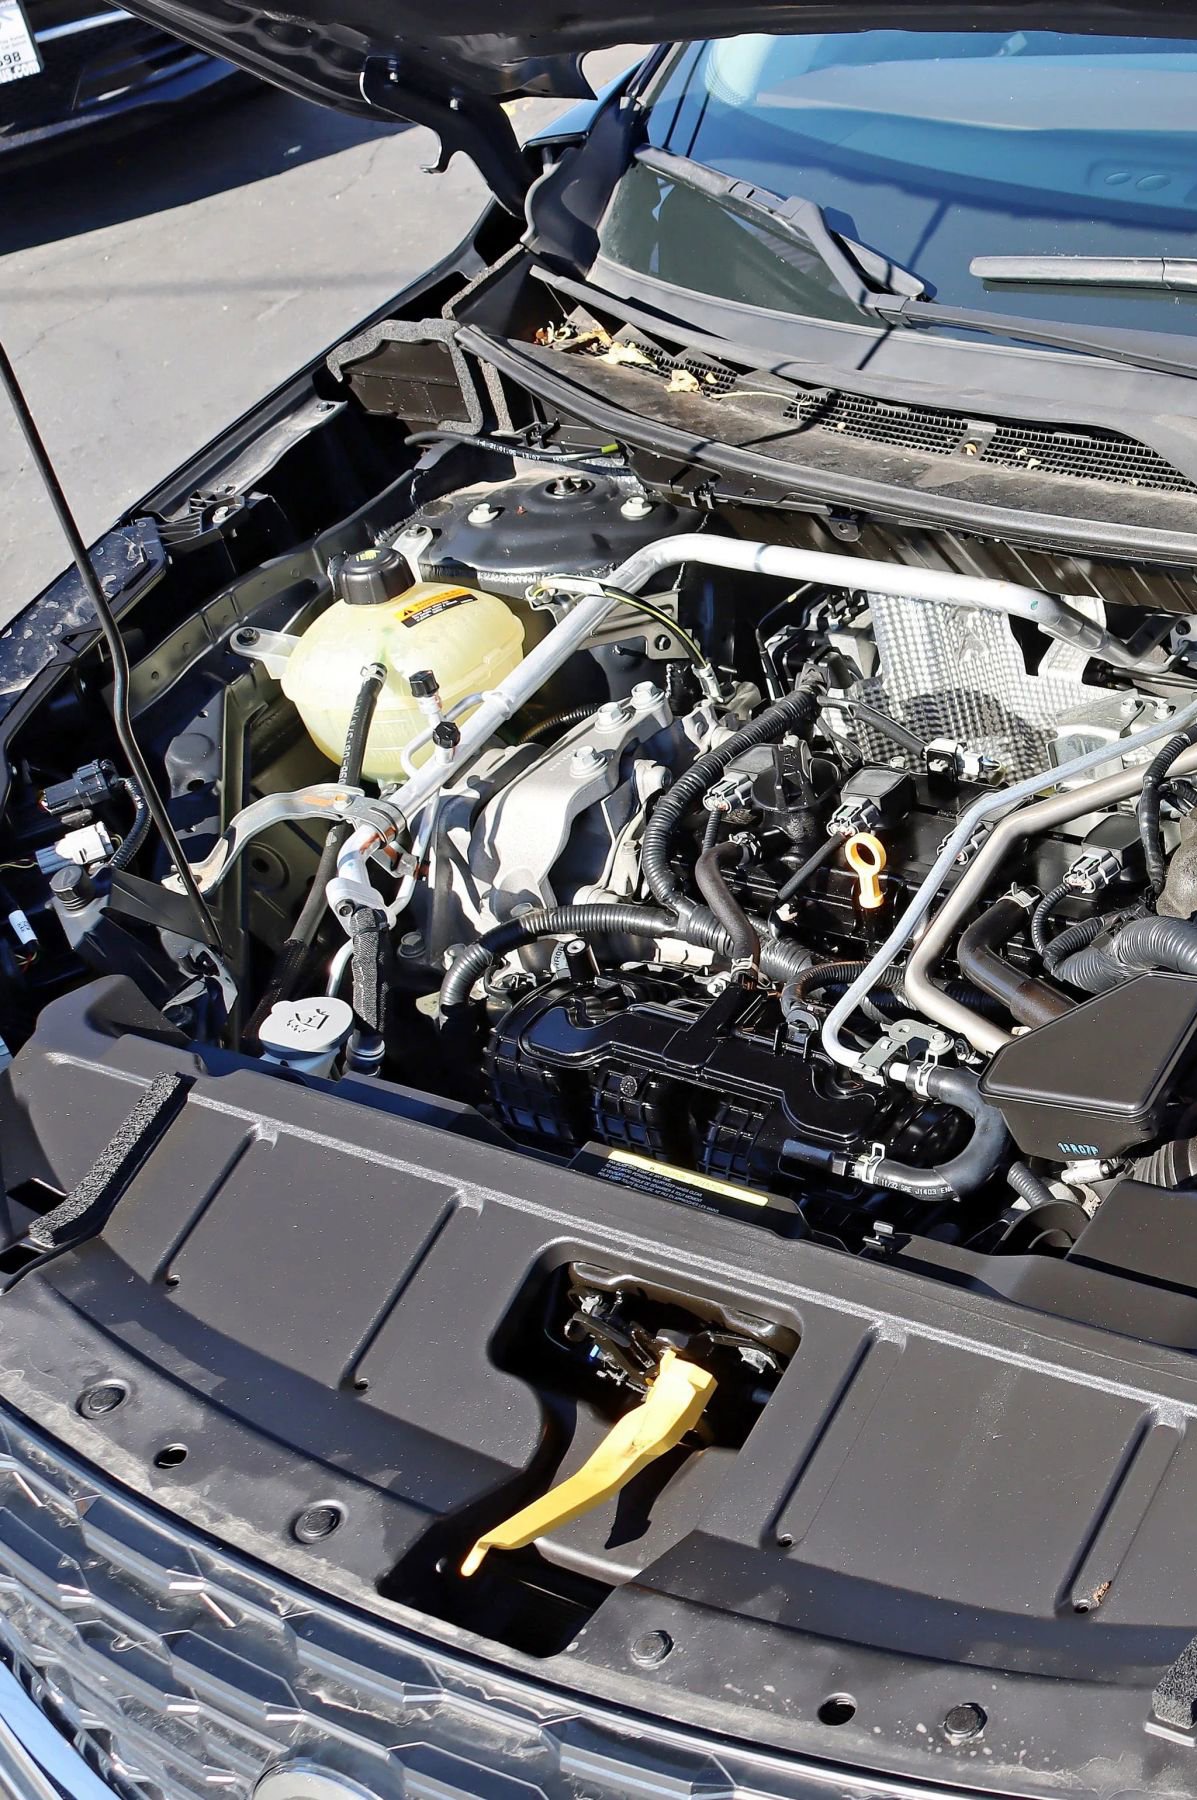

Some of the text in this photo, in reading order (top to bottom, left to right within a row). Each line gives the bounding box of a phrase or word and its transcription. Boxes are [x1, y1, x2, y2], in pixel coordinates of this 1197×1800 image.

[881, 1178, 899, 1189] 11/32
[900, 1185, 913, 1193] SAE
[915, 1187, 937, 1196] J1403
